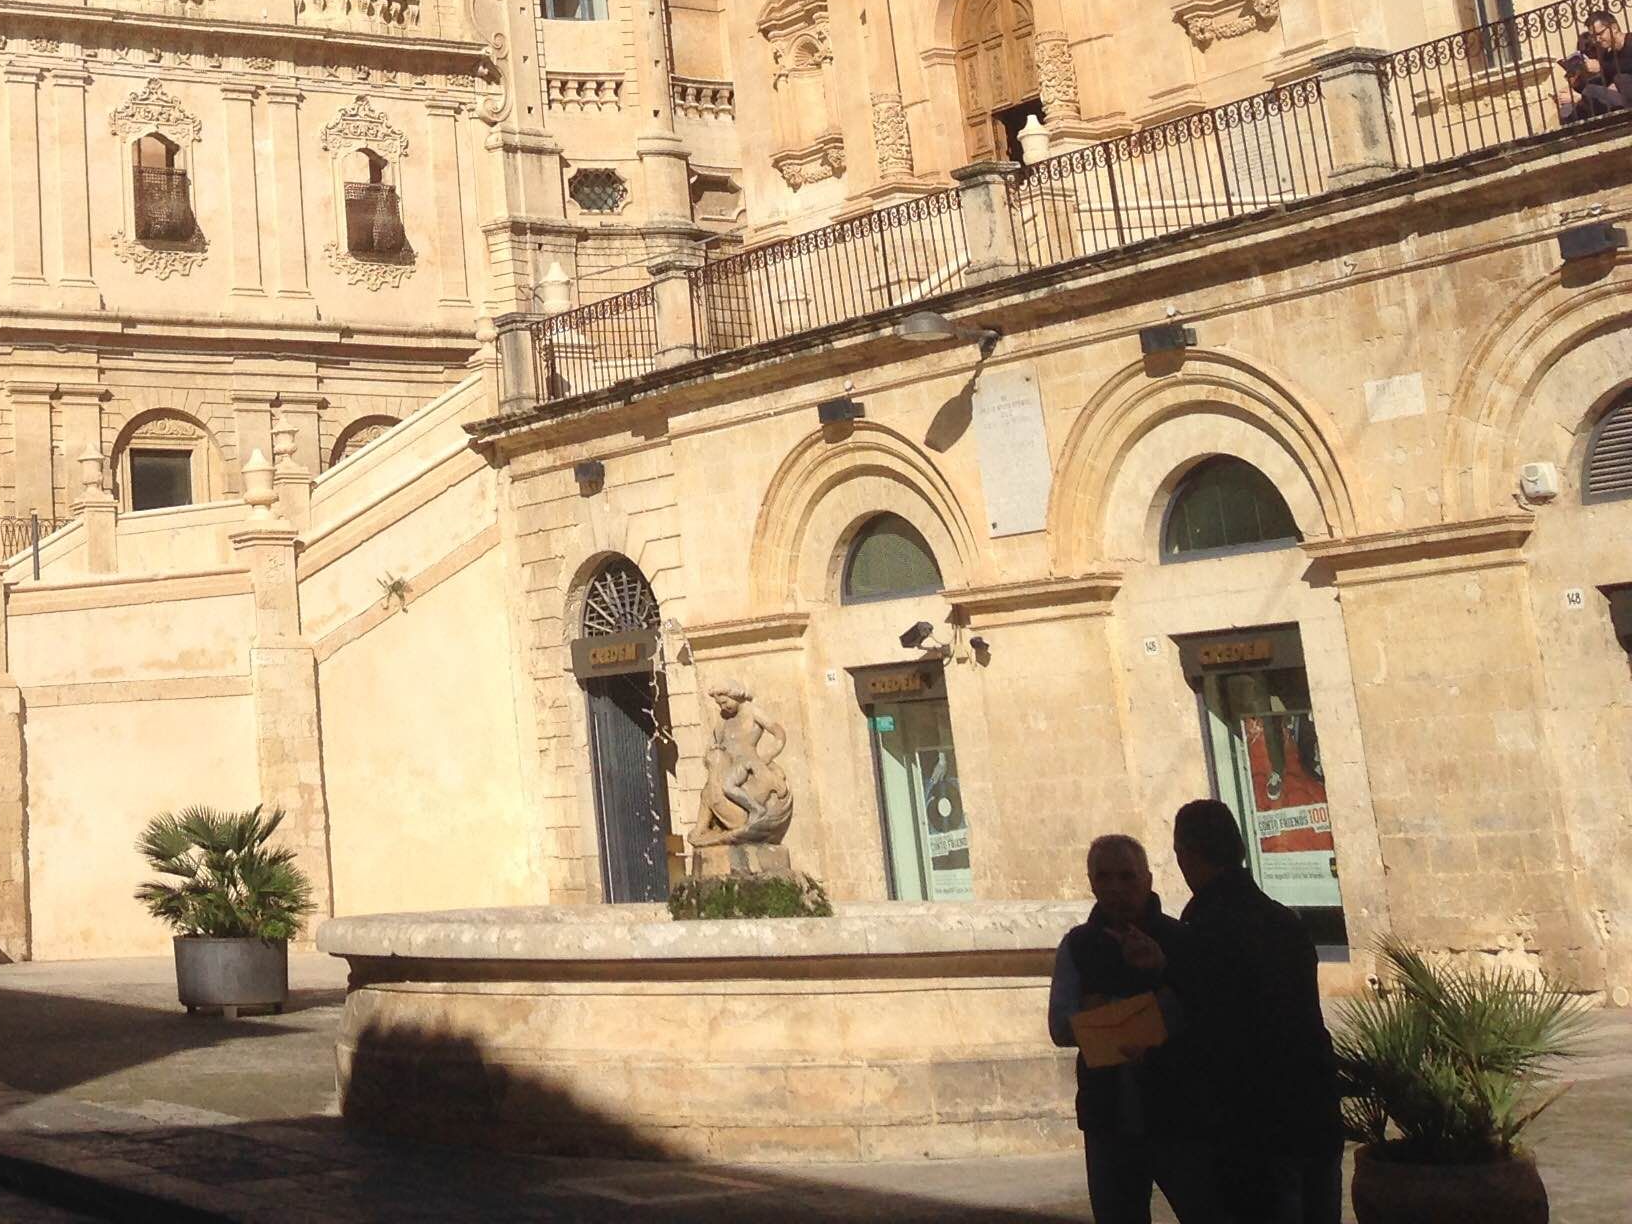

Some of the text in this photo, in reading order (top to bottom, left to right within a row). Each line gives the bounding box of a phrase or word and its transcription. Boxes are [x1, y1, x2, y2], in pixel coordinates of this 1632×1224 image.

[1567, 592, 1581, 605] 148
[590, 643, 637, 665] CREDEM
[870, 672, 922, 693] CREDEM
